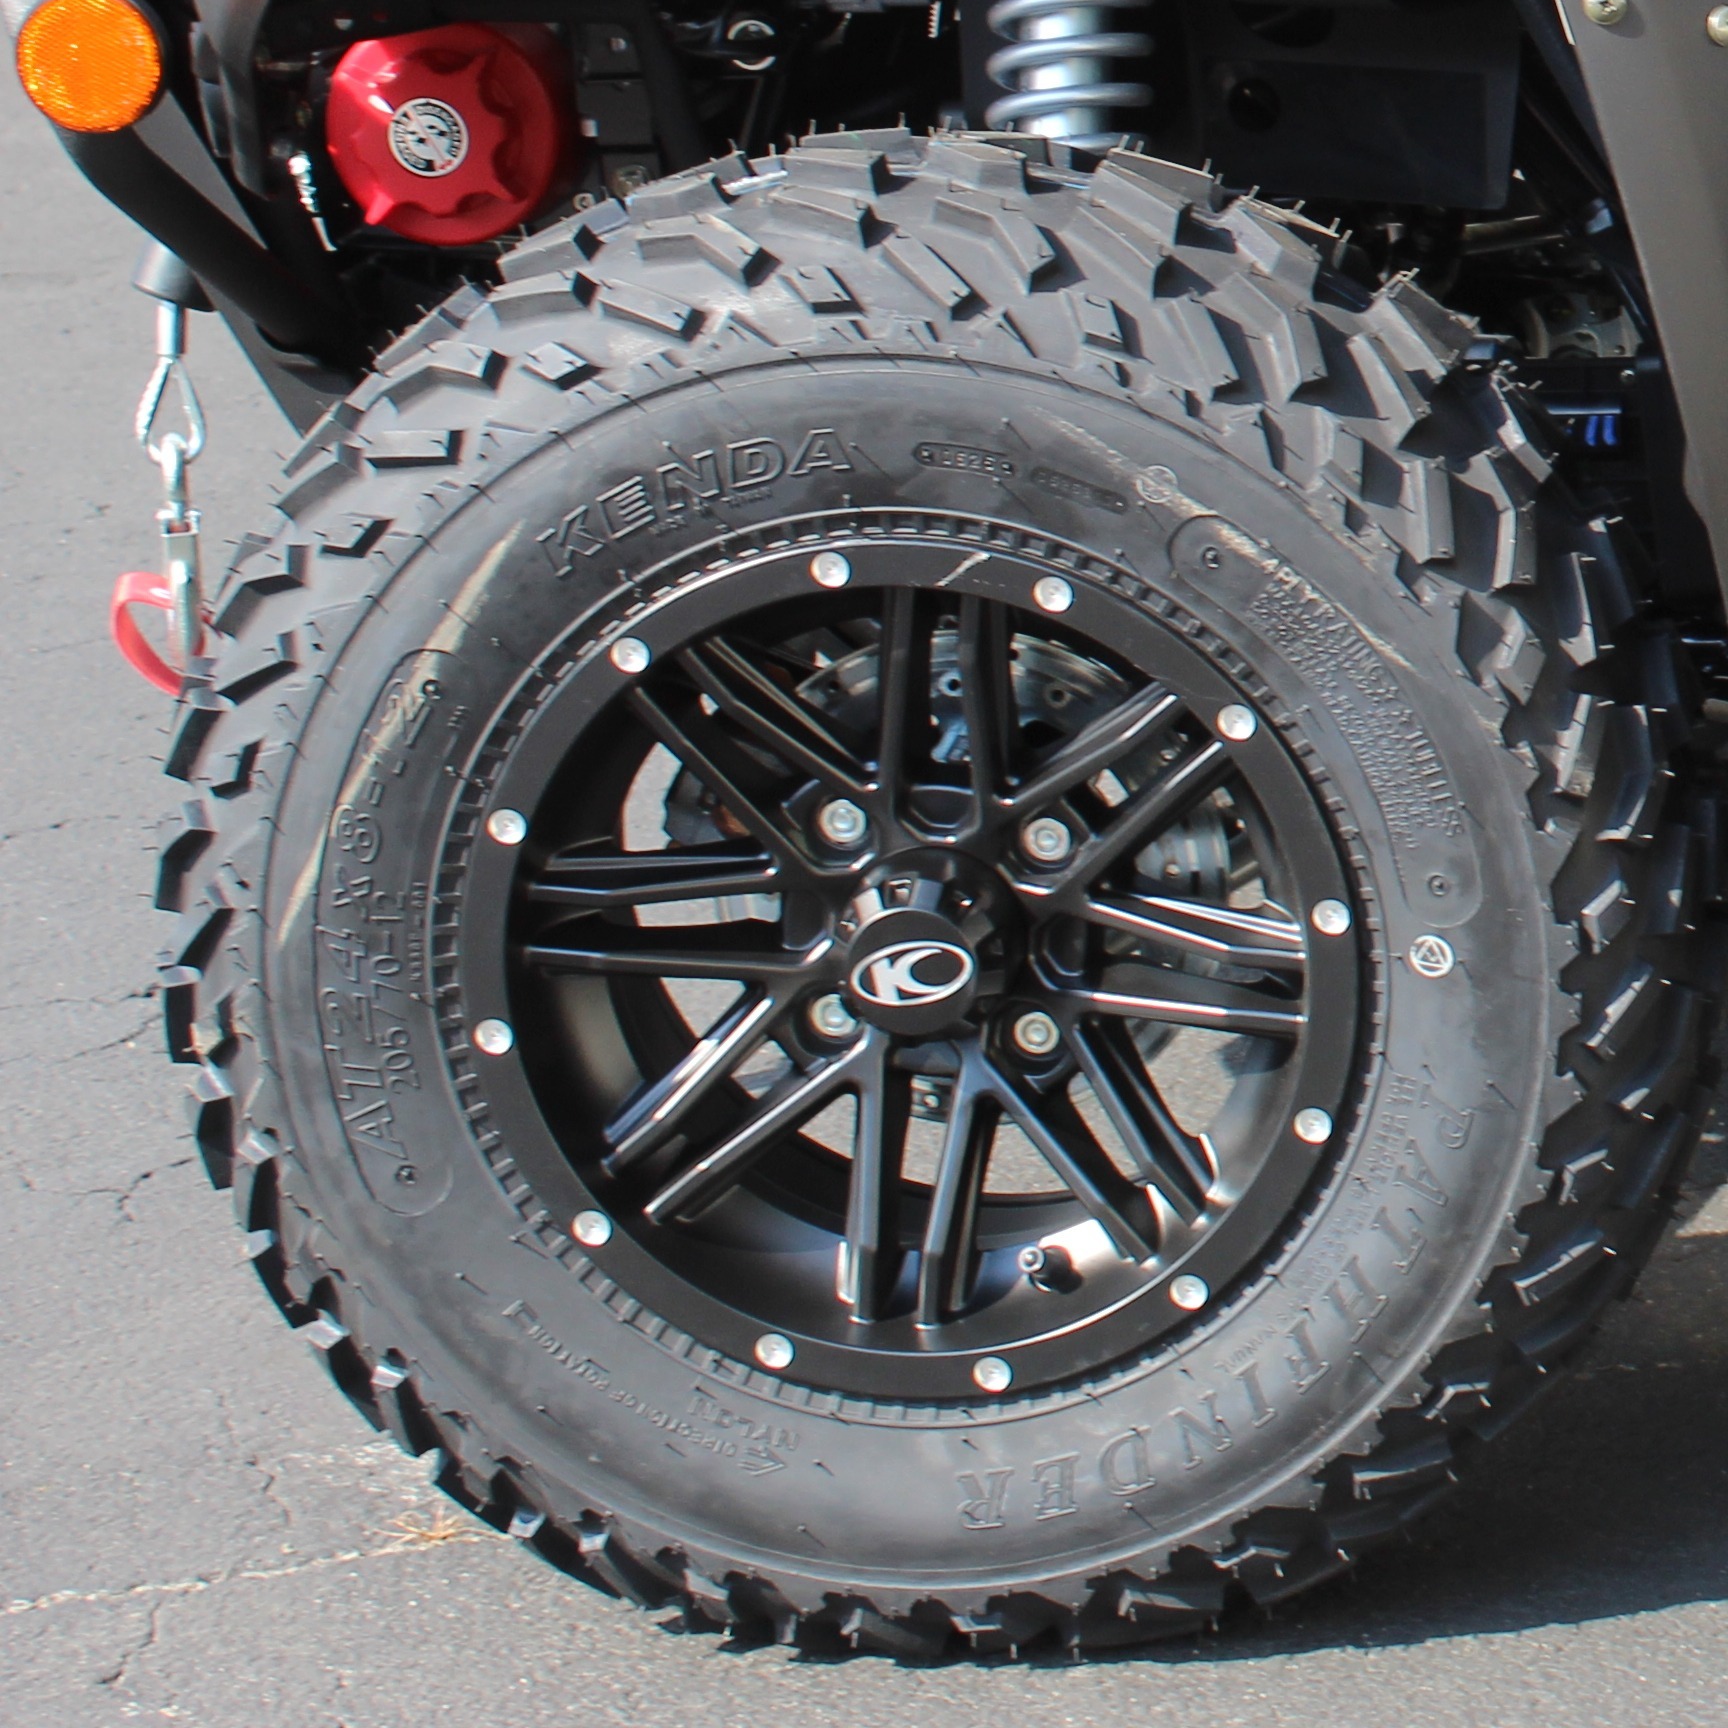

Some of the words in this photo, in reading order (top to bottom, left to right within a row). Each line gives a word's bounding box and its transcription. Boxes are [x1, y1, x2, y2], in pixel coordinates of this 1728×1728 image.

[535, 427, 853, 577] KENDA
[365, 886, 425, 1096] 205/70-12
[955, 1081, 1476, 1528] PATHFINDER
[528, 1324, 611, 1392] ROTATION
[608, 1388, 638, 1410] OF
[637, 1402, 739, 1458] DIRECTION
[687, 1395, 800, 1451] NYLON
